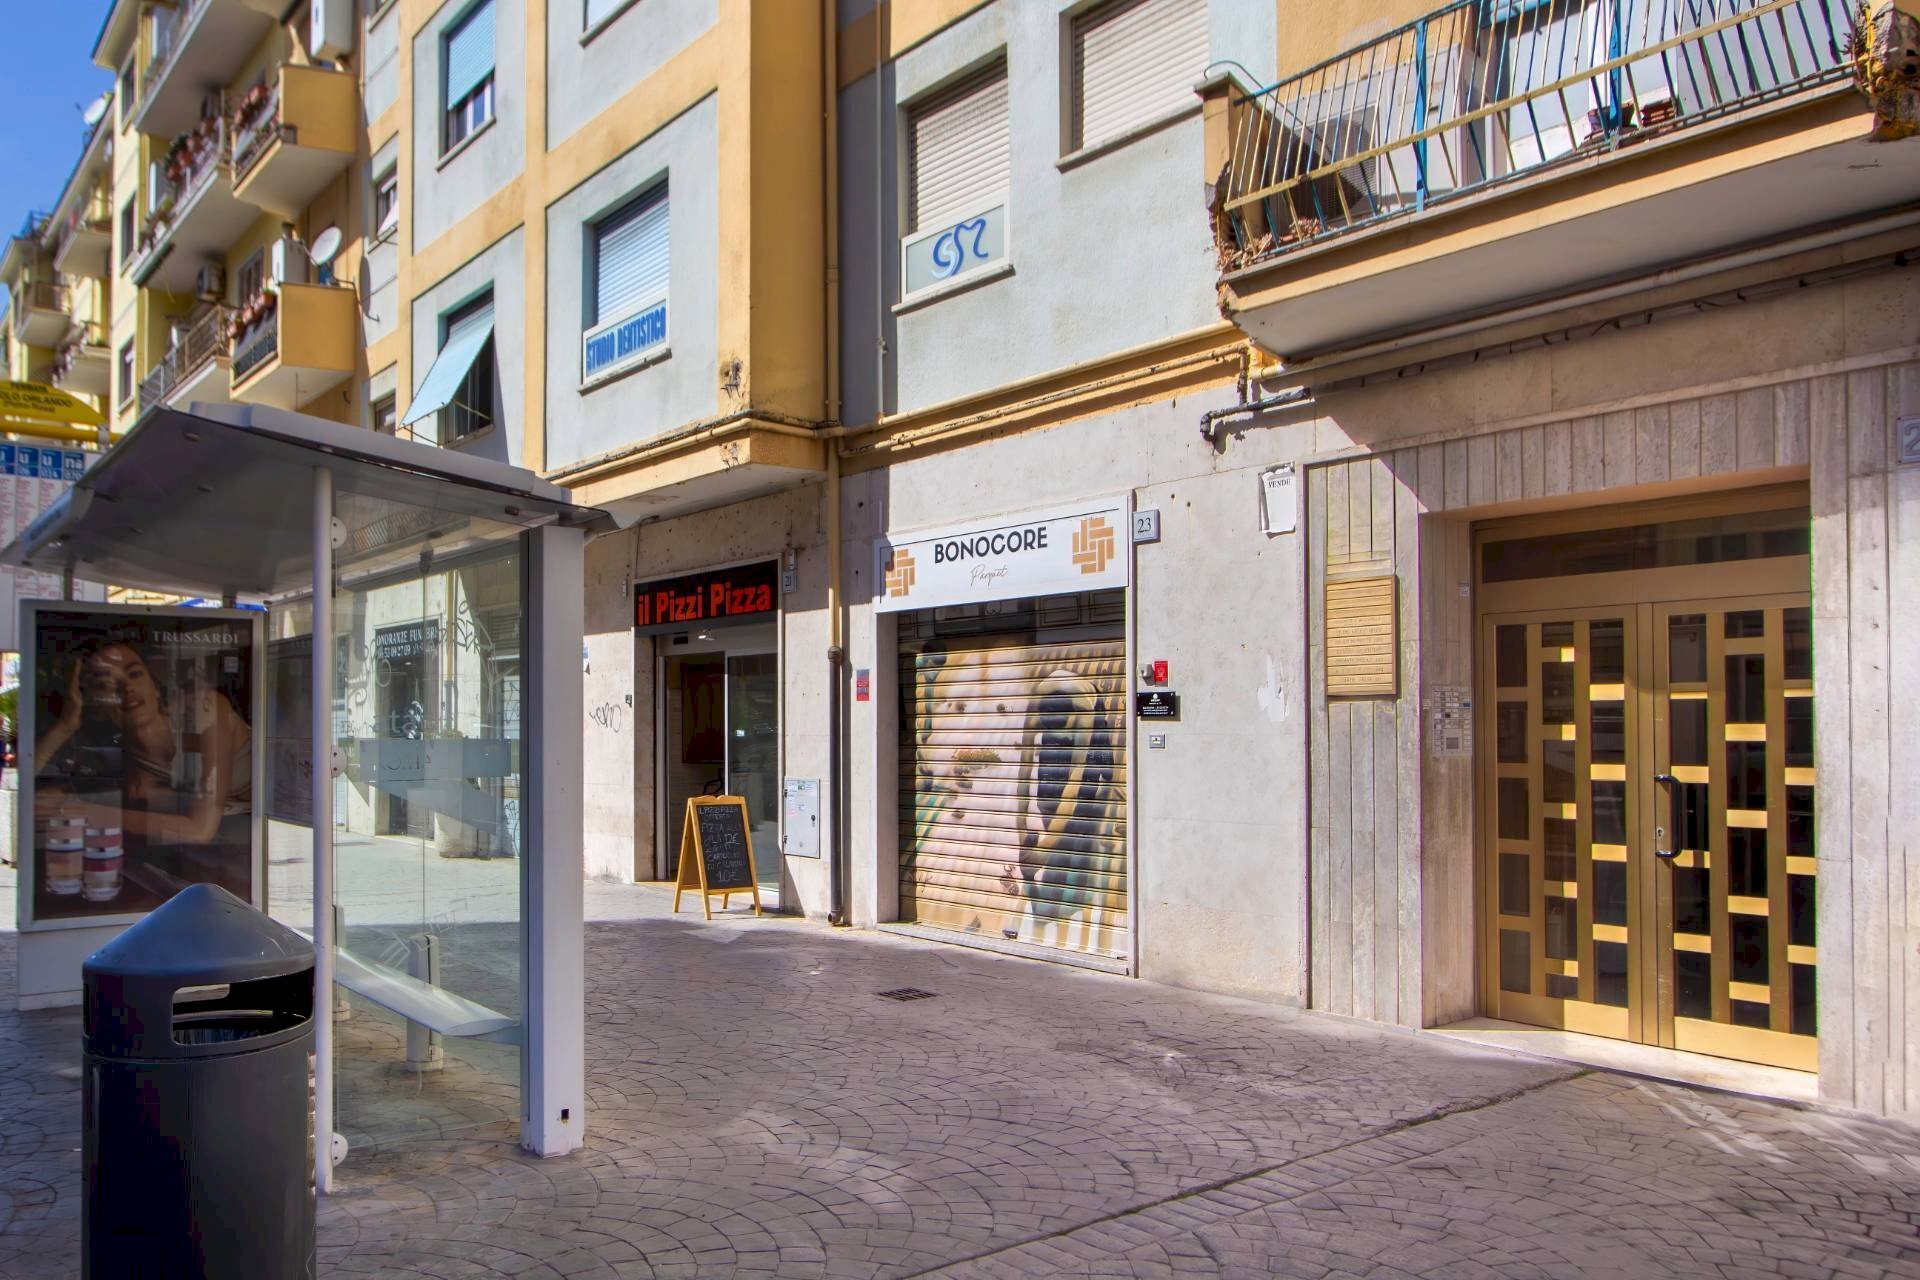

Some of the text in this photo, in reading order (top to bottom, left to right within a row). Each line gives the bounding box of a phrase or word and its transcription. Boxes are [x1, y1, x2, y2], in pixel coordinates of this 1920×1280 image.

[586, 306, 666, 371] STUDIO DENTISTICO
[1137, 517, 1152, 534] 23
[934, 526, 1048, 564] BONOCORE
[637, 582, 771, 625] il Pizzi Pizza
[152, 630, 239, 645] TRUSSARDI
[376, 630, 409, 647] ONORANZE
